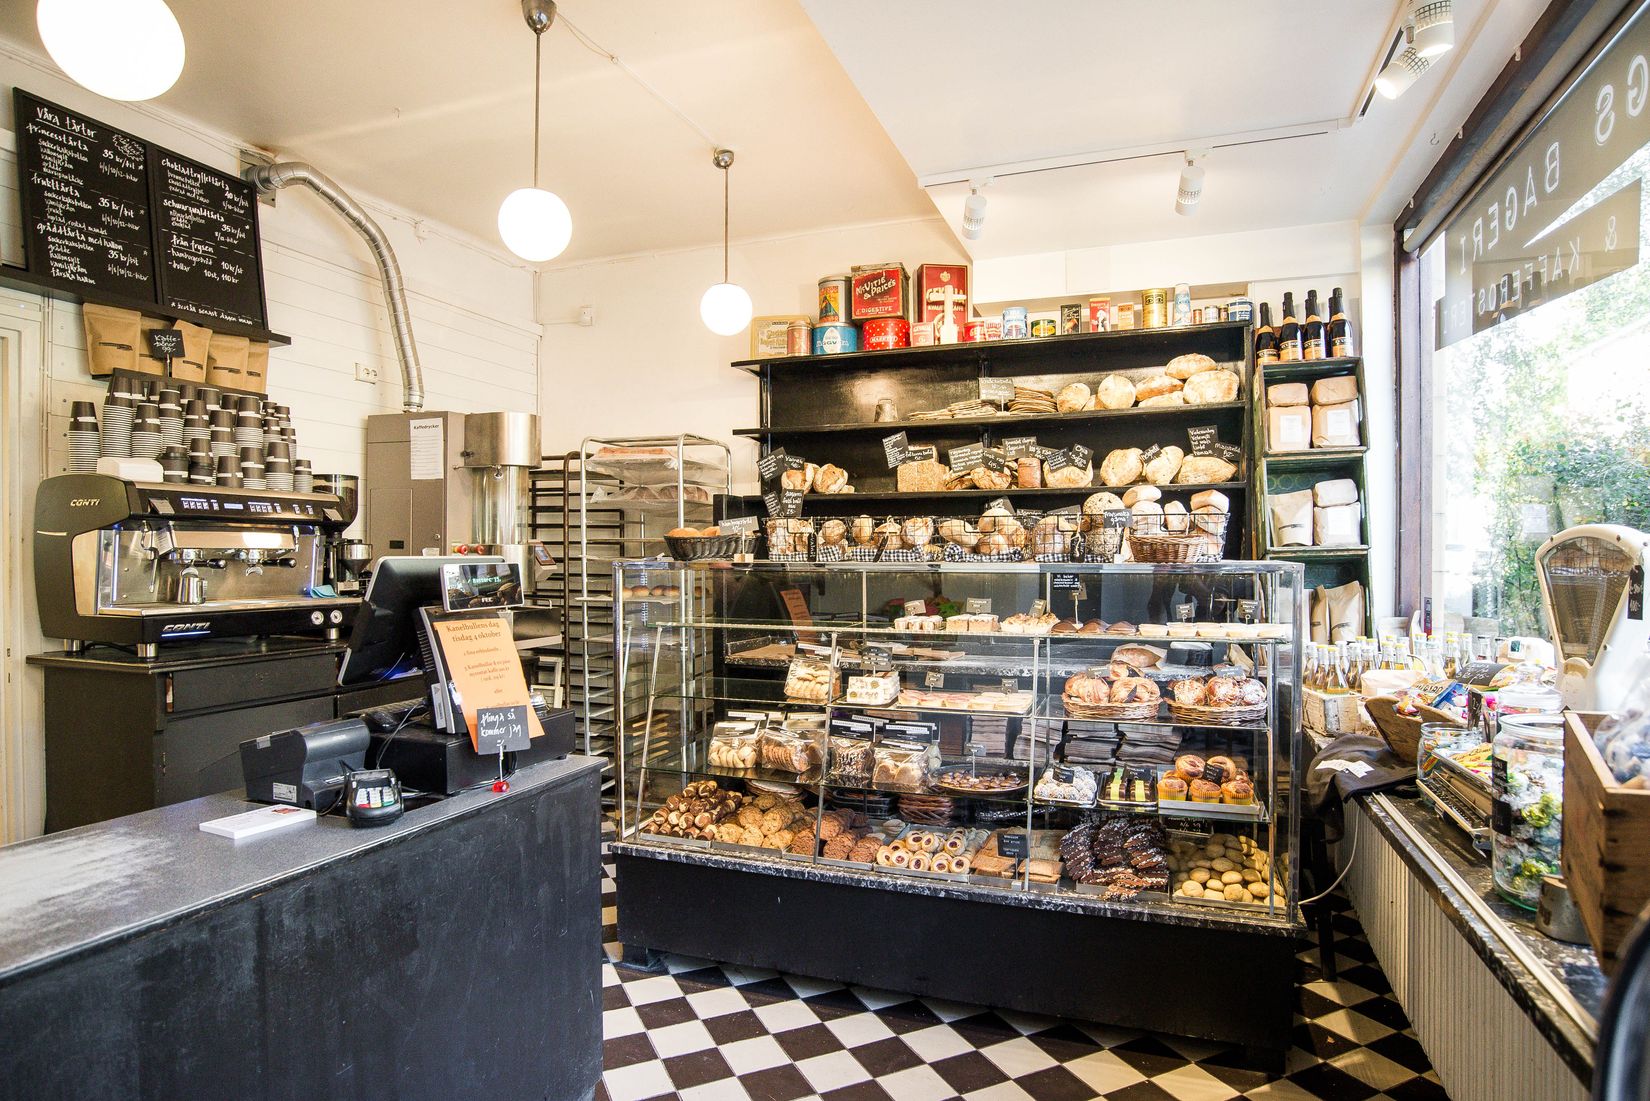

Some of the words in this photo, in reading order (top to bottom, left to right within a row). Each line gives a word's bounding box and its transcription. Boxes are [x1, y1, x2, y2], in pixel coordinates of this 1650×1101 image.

[36, 107, 60, 126] Våra
[66, 116, 98, 138] tårtor
[102, 149, 114, 160] 35
[31, 173, 80, 198] frukttårta
[98, 197, 110, 208] 35
[87, 236, 103, 246] med
[170, 234, 189, 247] från
[190, 240, 214, 254] frysen
[108, 250, 119, 259] 35
[863, 292, 871, 300] &
[70, 498, 100, 507] CONTI
[163, 622, 210, 632] CONTI
[446, 622, 488, 633] Kanelbullens
[489, 621, 500, 630] dag
[452, 634, 473, 642] tisdag
[478, 630, 502, 640] oktober
[507, 708, 516, 720] så
[480, 726, 506, 737] kommer
[508, 724, 521, 738] jag
